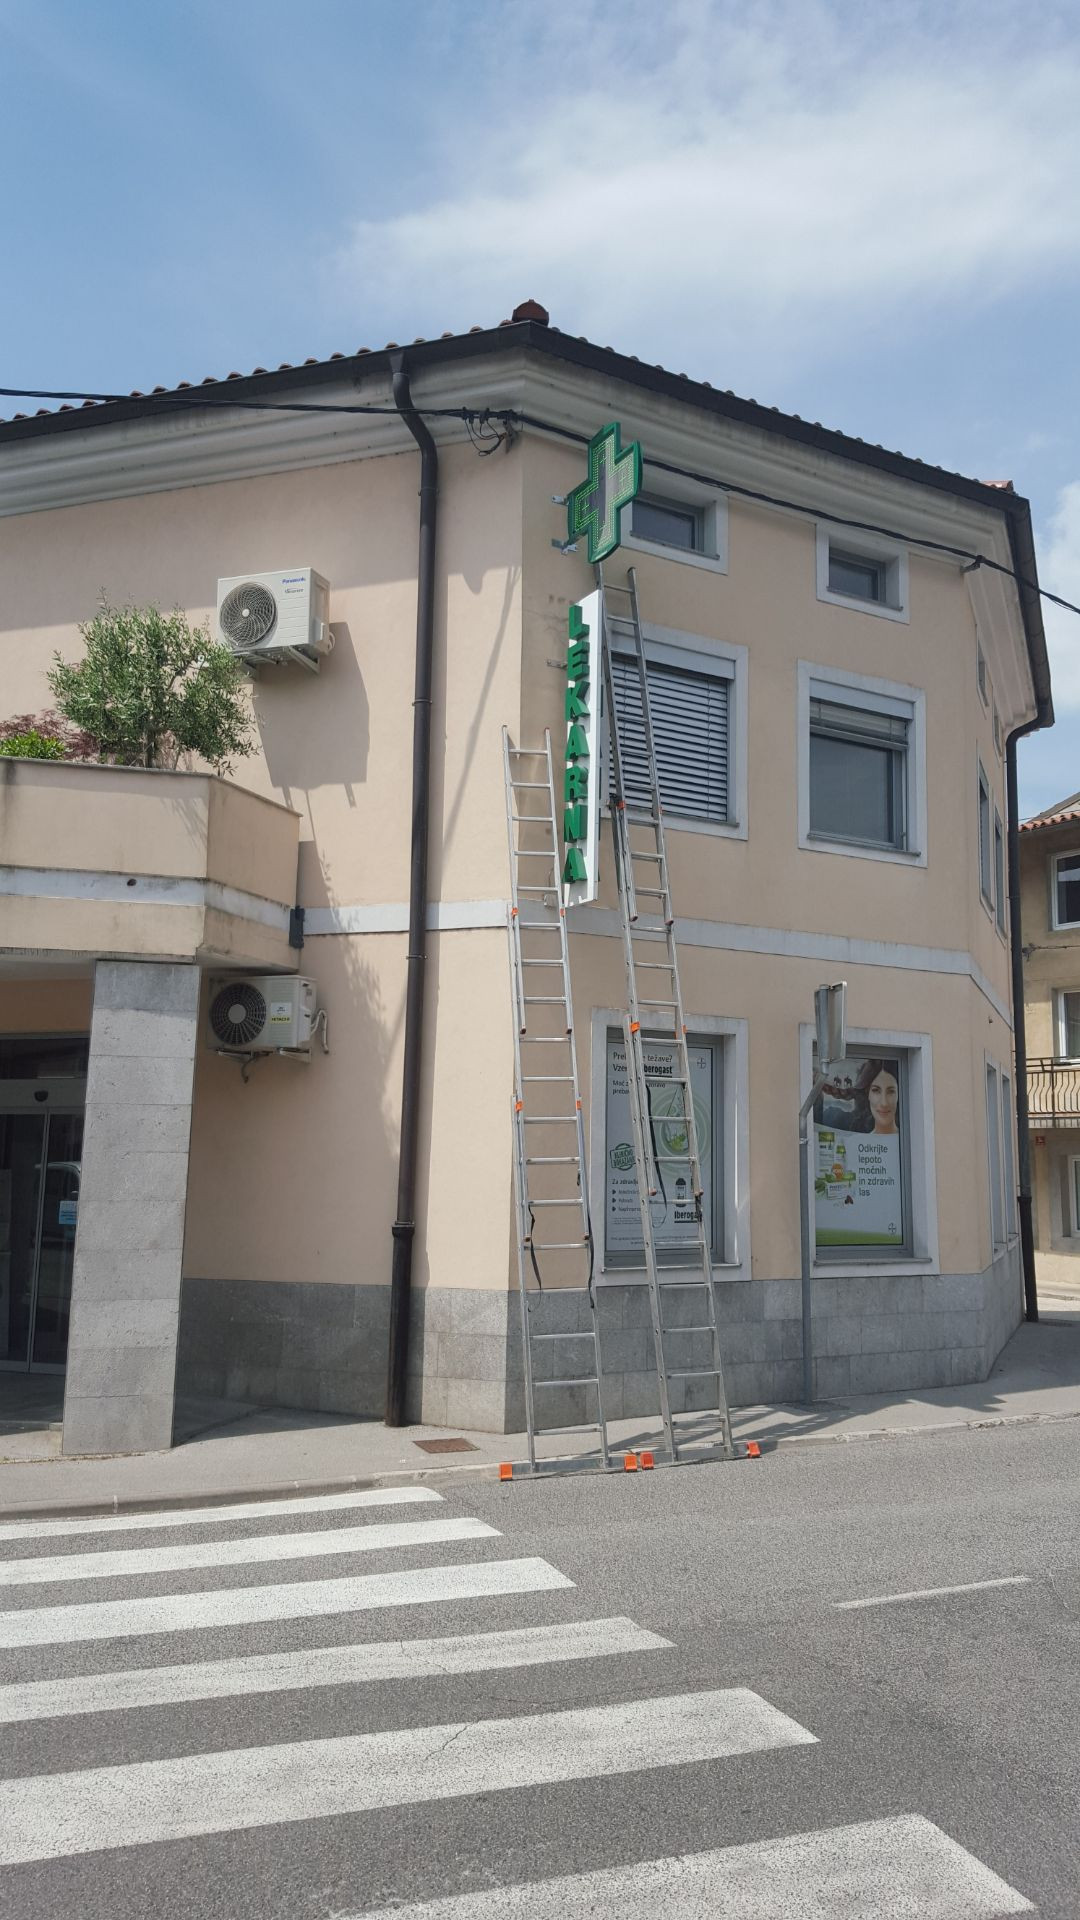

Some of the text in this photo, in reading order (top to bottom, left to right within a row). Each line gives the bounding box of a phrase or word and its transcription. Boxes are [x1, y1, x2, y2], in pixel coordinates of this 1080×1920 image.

[564, 604, 590, 883] LEKARNA
[647, 1054, 673, 1063] težave?
[643, 1064, 673, 1075] berogast
[858, 1144, 888, 1154] Odkrijte
[858, 1155, 882, 1165] lepoto
[858, 1166, 887, 1174] močnih
[858, 1177, 895, 1186] in zdravih
[858, 1188, 871, 1197] las
[674, 1211, 699, 1221] Iberoga
